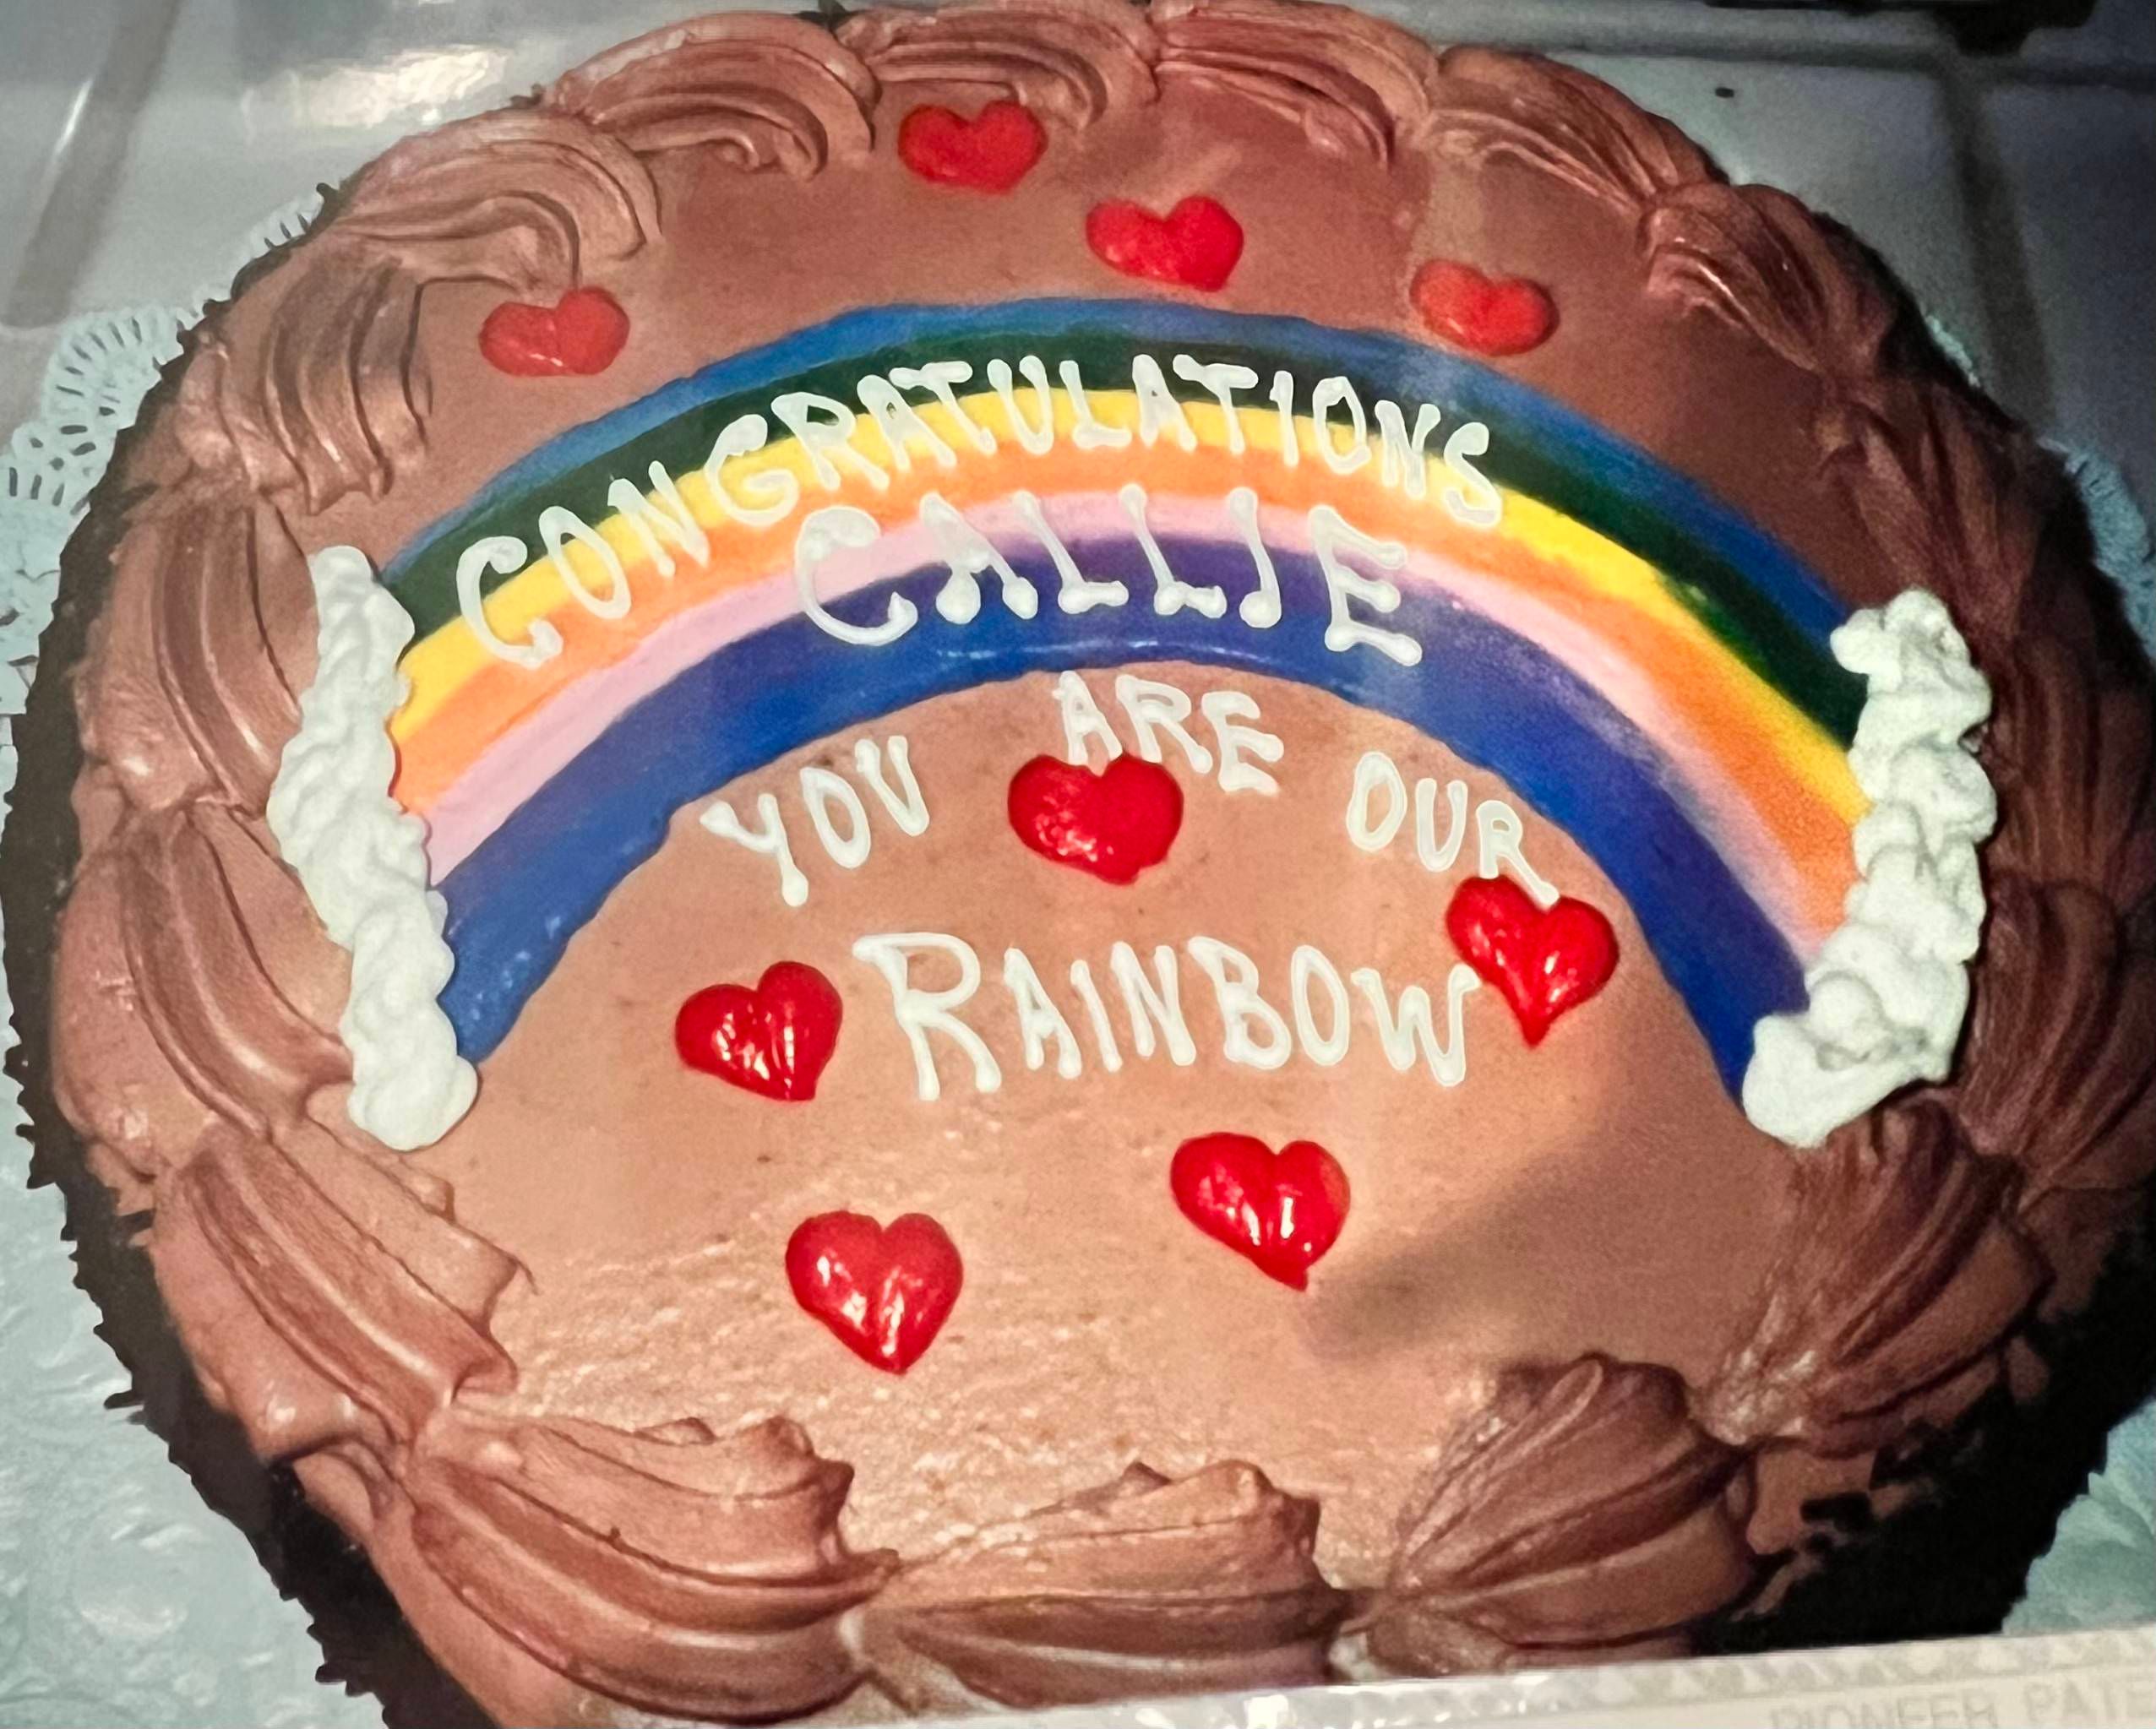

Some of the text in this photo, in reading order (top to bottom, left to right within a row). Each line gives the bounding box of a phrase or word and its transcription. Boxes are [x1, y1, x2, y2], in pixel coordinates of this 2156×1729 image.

[457, 354, 1502, 667] CONGRATULATIONS
[796, 485, 1422, 666] CALLIE
[700, 670, 1560, 906] YOU ARE OUR
[852, 932, 1482, 1101] RAINBOW
